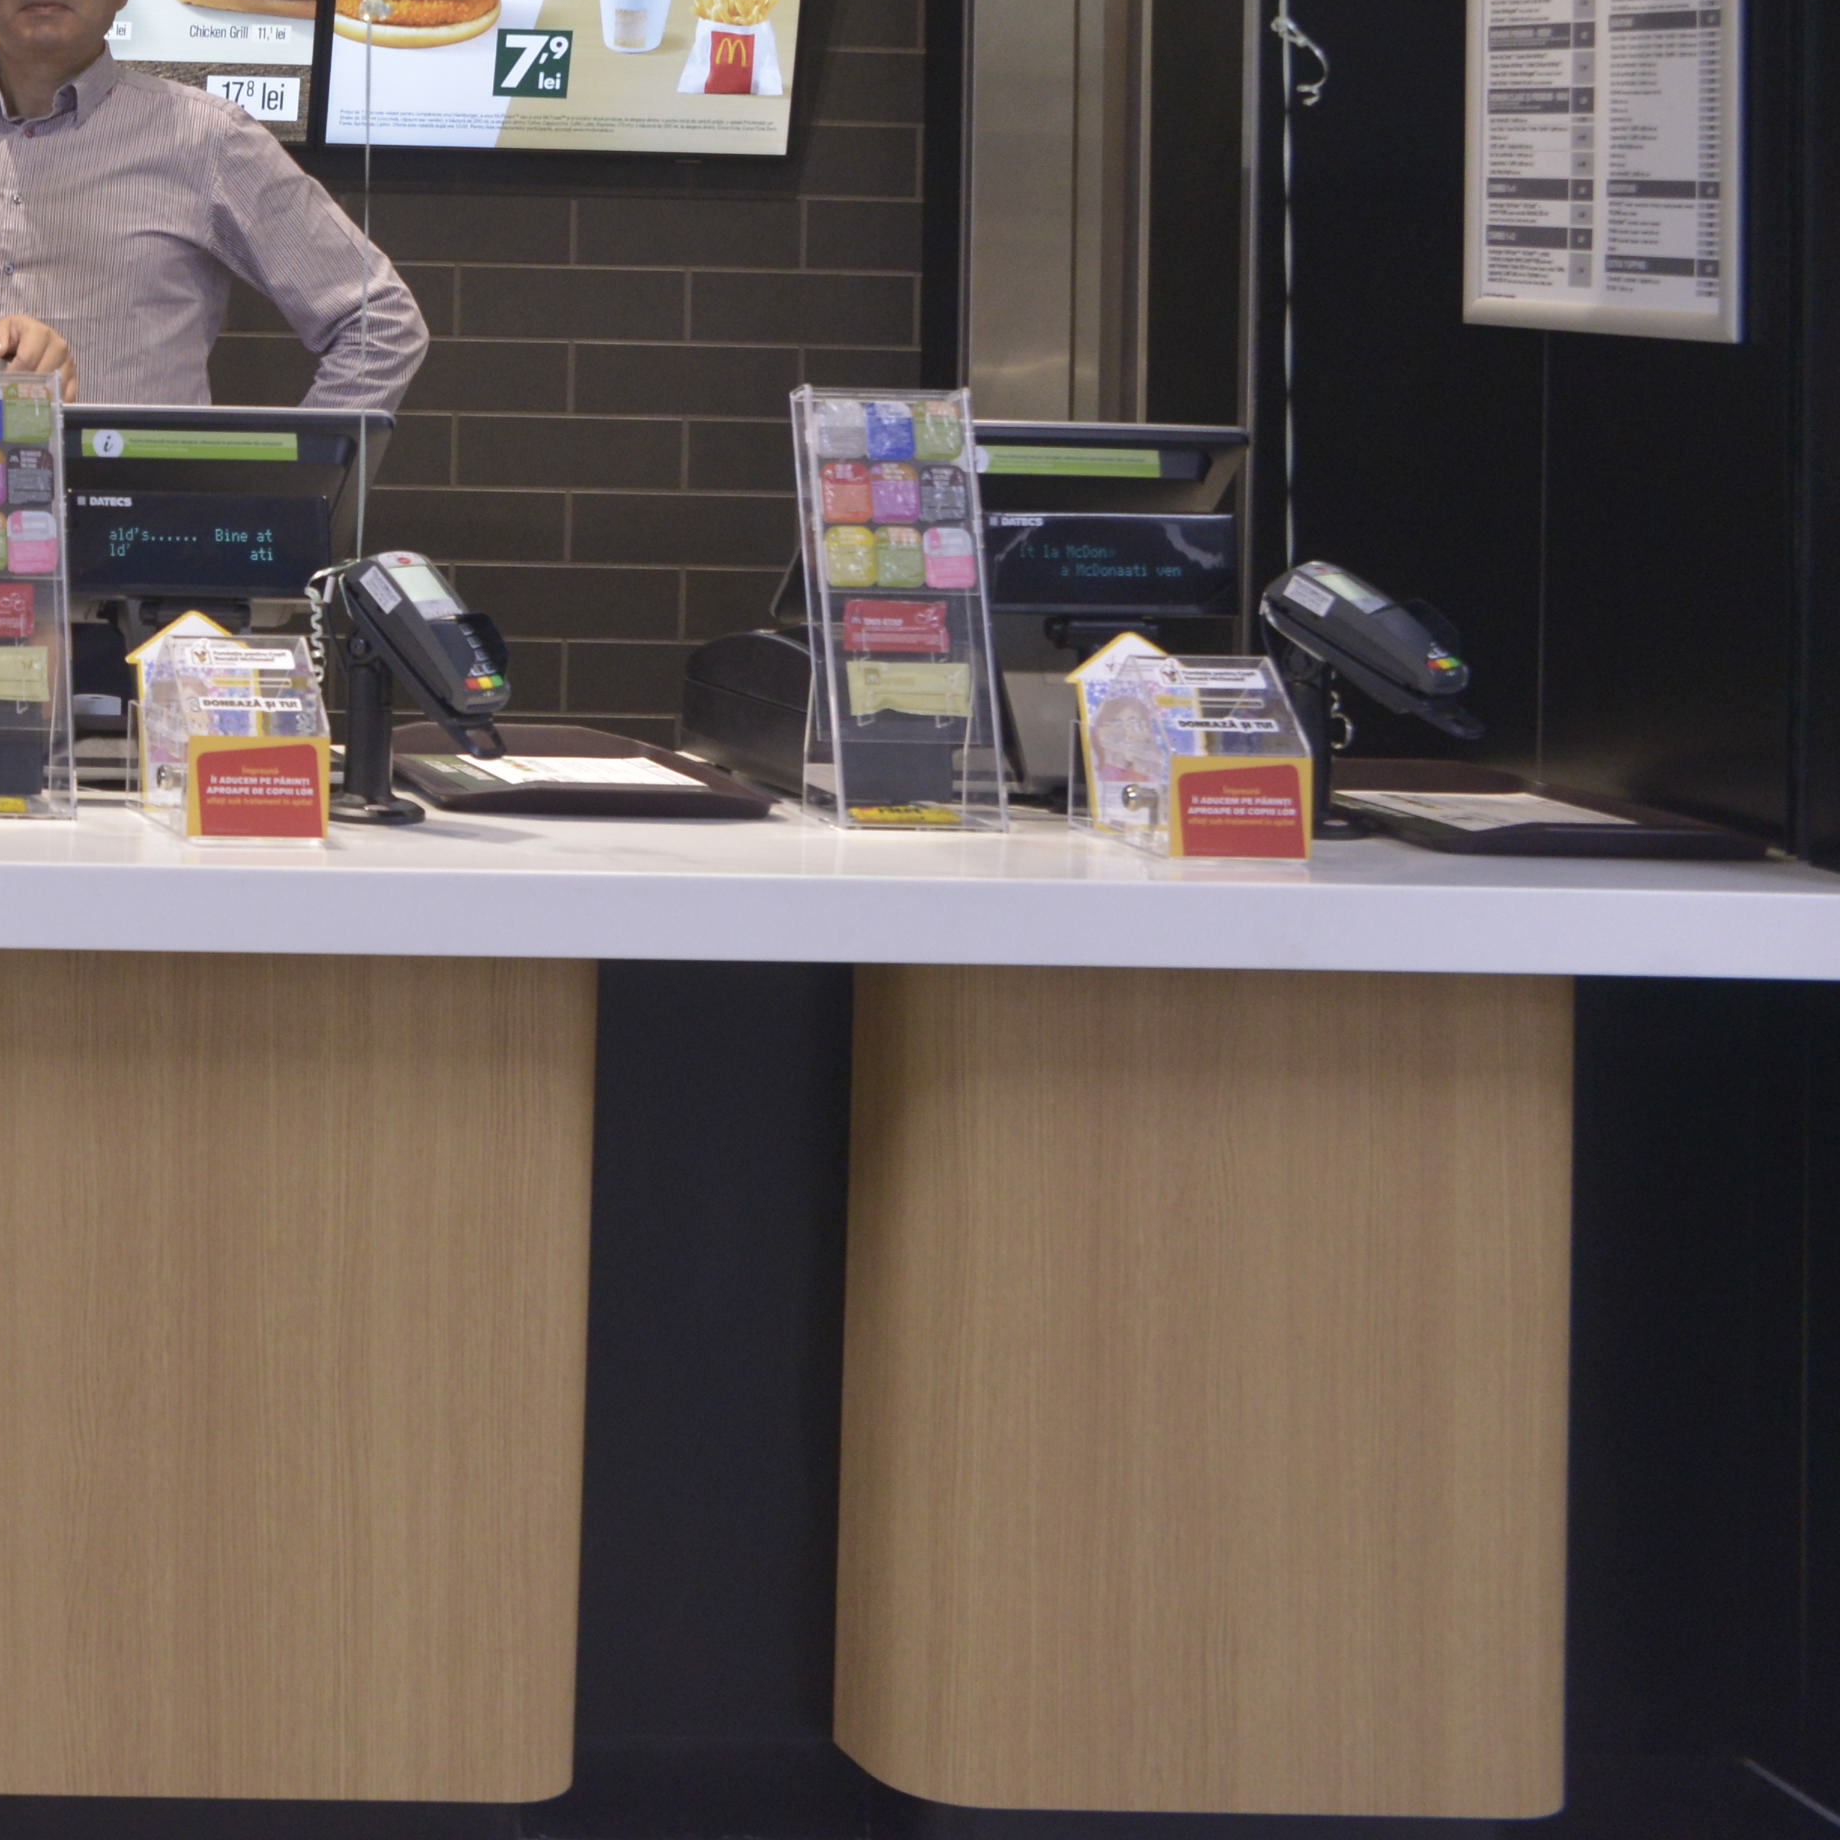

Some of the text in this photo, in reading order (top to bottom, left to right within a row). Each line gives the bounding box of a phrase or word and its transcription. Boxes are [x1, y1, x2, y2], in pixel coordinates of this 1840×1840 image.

[189, 25, 227, 39] Chicken
[229, 26, 248, 39] Grill
[275, 27, 286, 40] lei
[538, 72, 561, 90] lei
[261, 82, 285, 110] lei
[89, 497, 133, 507] DATECS
[1001, 517, 1044, 527] DATECS
[214, 529, 248, 543] Bine
[256, 530, 273, 543] at
[250, 549, 273, 561] ati
[260, 777, 272, 785] PE
[206, 786, 250, 795] APROAPE
[252, 787, 264, 795] DE
[295, 788, 314, 796] LOR
